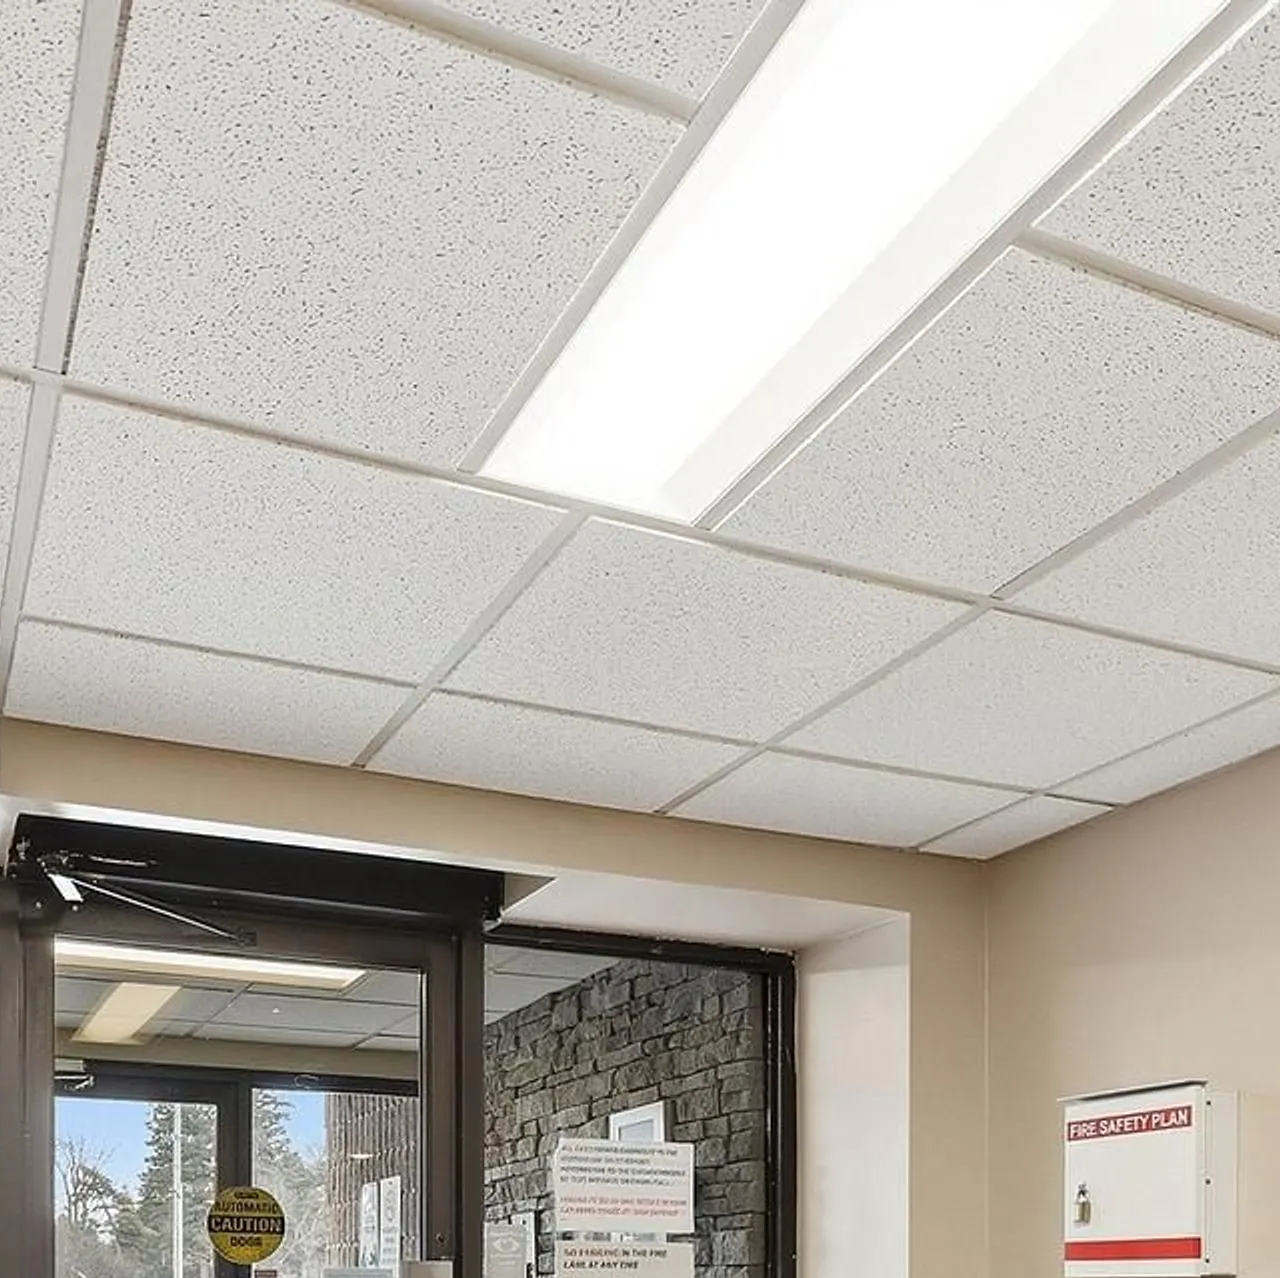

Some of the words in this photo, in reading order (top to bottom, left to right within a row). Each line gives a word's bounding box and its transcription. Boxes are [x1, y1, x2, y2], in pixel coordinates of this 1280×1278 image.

[1069, 1122, 1098, 1139] FIRE
[1099, 1114, 1151, 1135] SAFETY
[1151, 1109, 1189, 1129] PLAN
[211, 1217, 282, 1232] CAUTION
